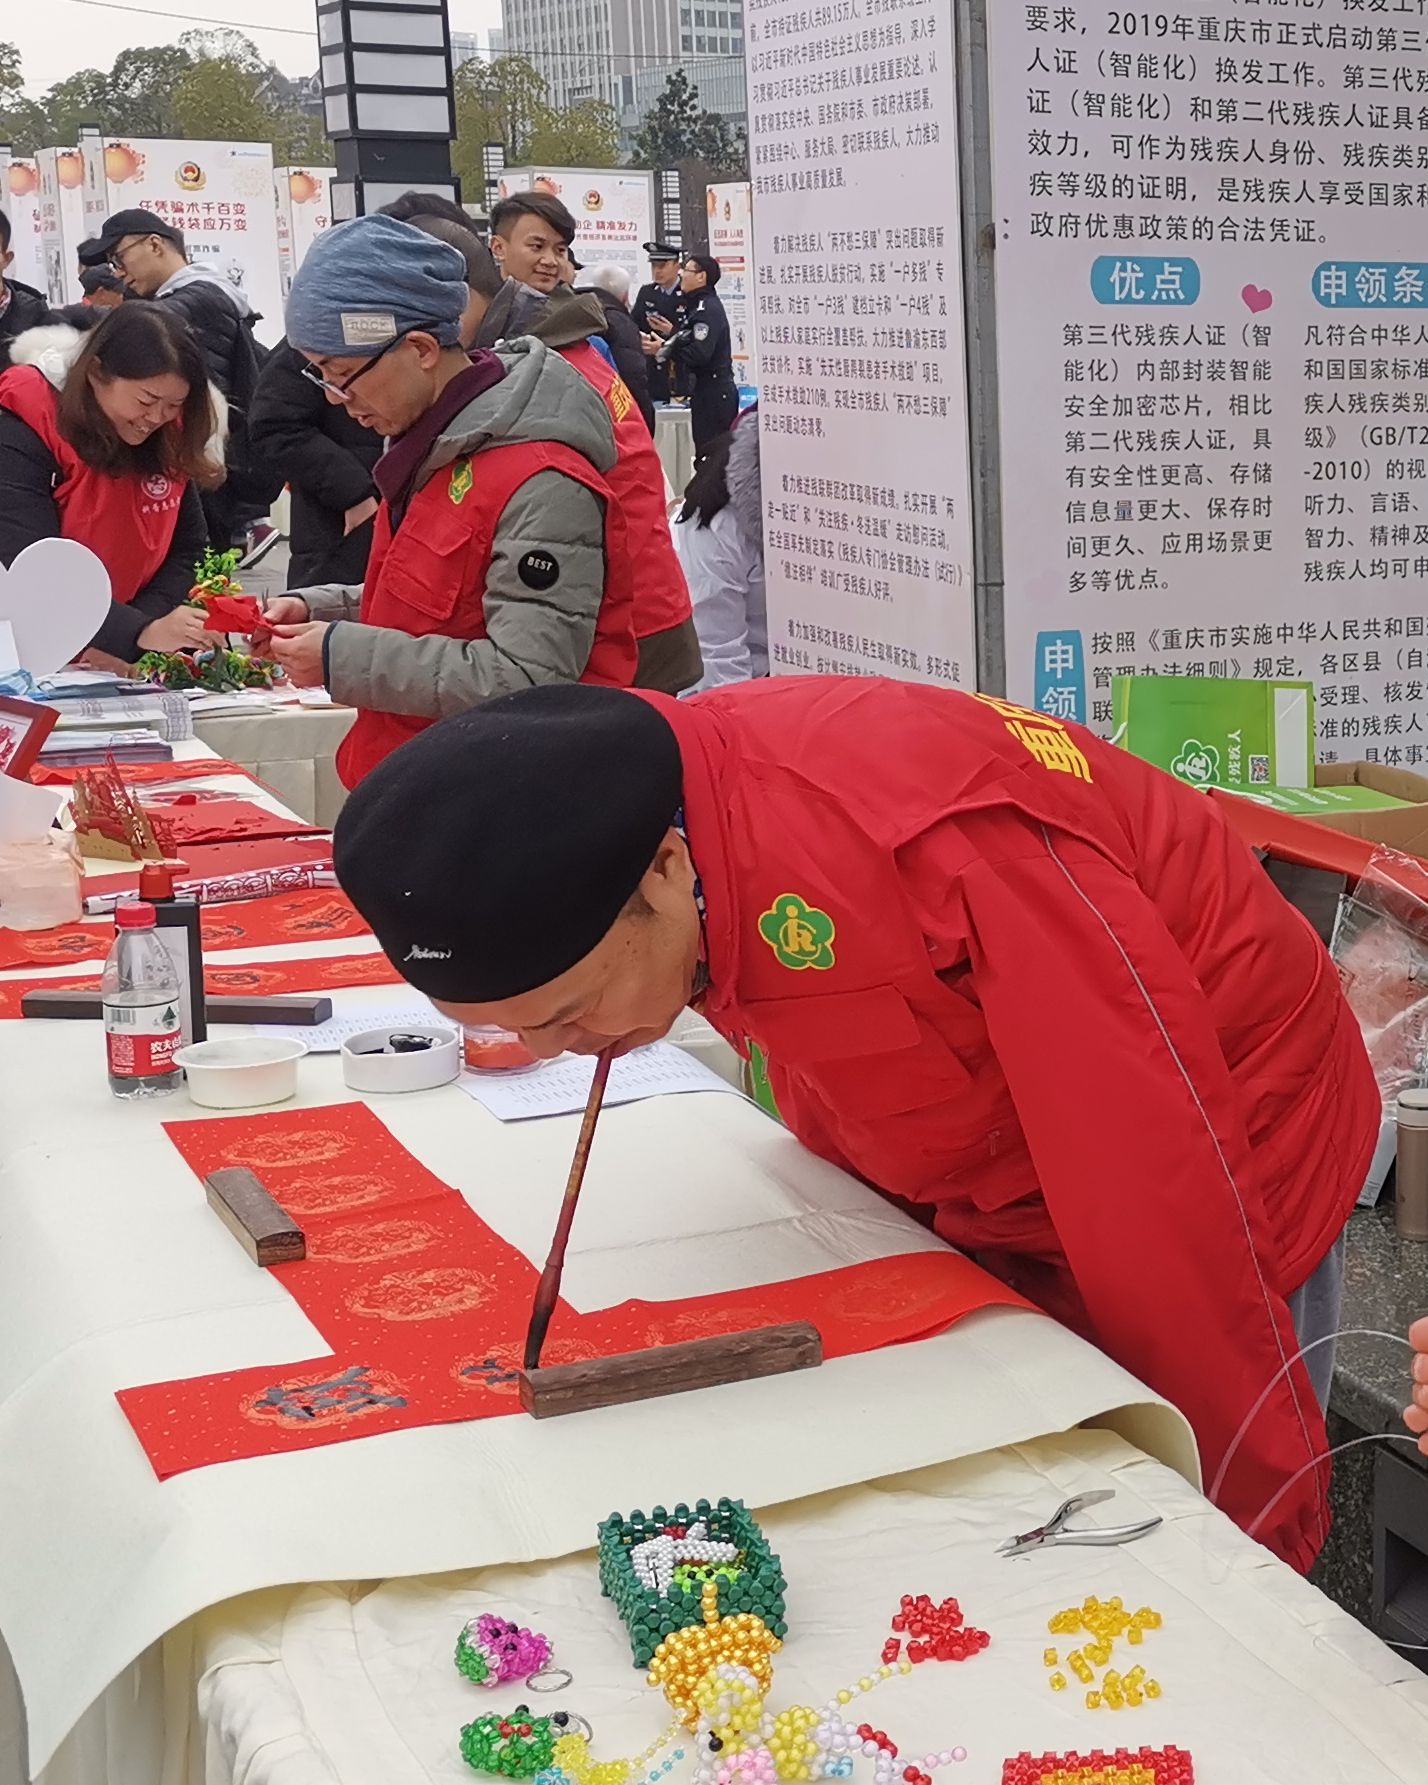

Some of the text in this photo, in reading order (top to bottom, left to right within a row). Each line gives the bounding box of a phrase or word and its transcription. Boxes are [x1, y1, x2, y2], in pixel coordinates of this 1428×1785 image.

[163, 216, 248, 232] 钱袋应万变
[1030, 211, 1327, 244] 政府优惠政策的合法凭证。
[1109, 261, 1185, 300] 优点
[1063, 323, 1272, 347] 第三代残疾人证（智
[1064, 358, 1272, 382] 能化）内部封装智能
[1064, 393, 1273, 418] 安全加密芯片，相比
[1064, 428, 1273, 454] 第二代残疾人证，具
[1065, 461, 1273, 488] 有安全性更高、存储
[1065, 495, 1273, 524] 信息量更大、保存时
[1066, 530, 1273, 559] 间更久、应用场景更
[527, 556, 553, 571] BEST
[1068, 567, 1169, 593] 多等优点。
